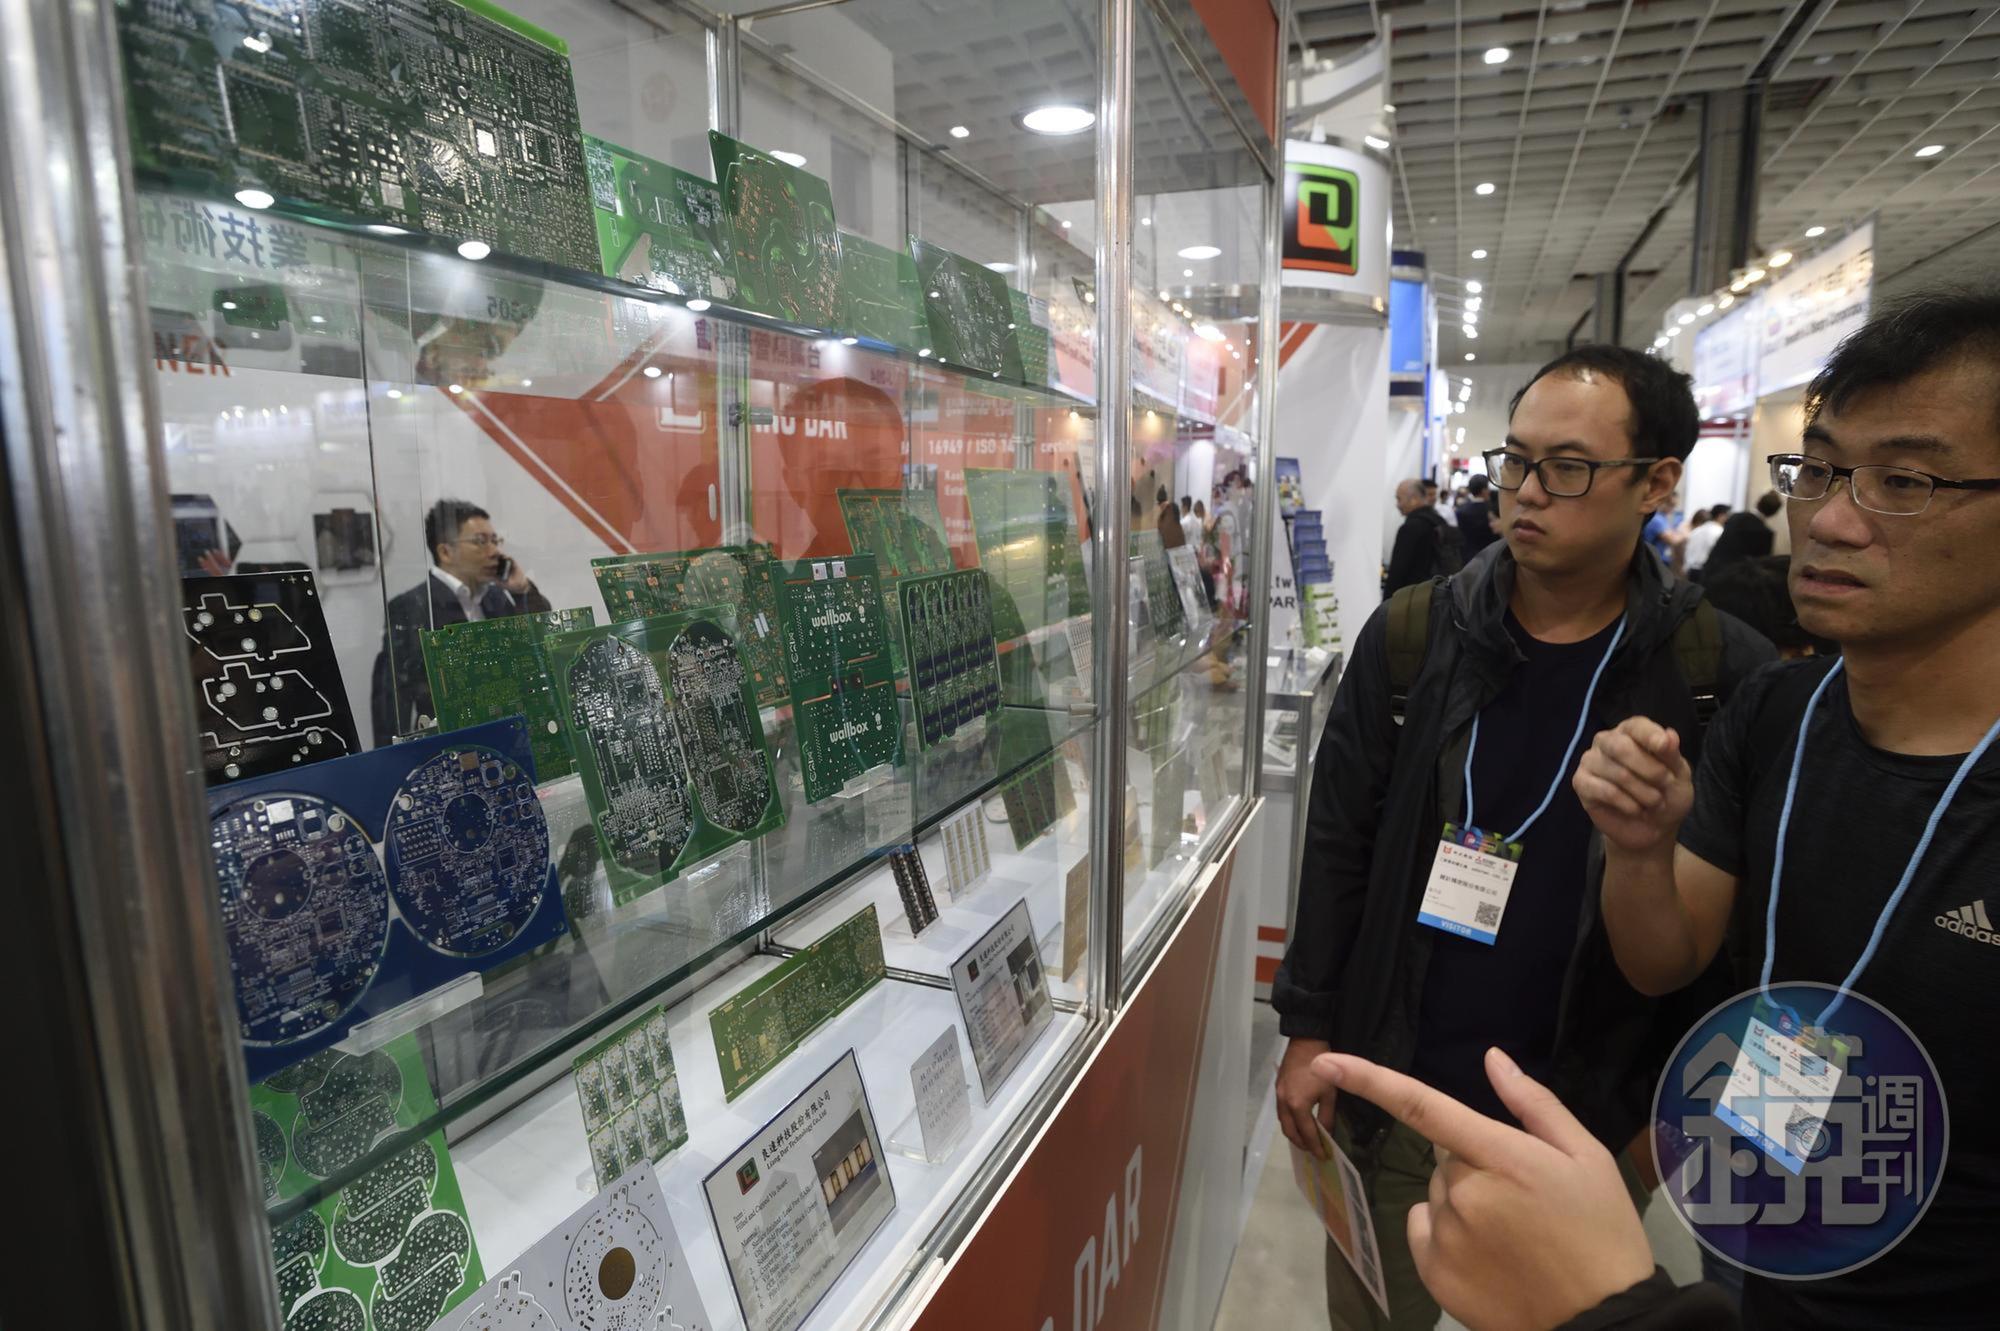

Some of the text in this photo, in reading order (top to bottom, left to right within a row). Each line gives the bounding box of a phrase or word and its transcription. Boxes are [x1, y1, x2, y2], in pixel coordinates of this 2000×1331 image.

[812, 608, 852, 628] wallbox
[829, 721, 869, 744] wallbox
[1441, 919, 1472, 936] VISITOR
[1934, 915, 2000, 946] adidas
[1740, 1121, 1776, 1152] VISITOR
